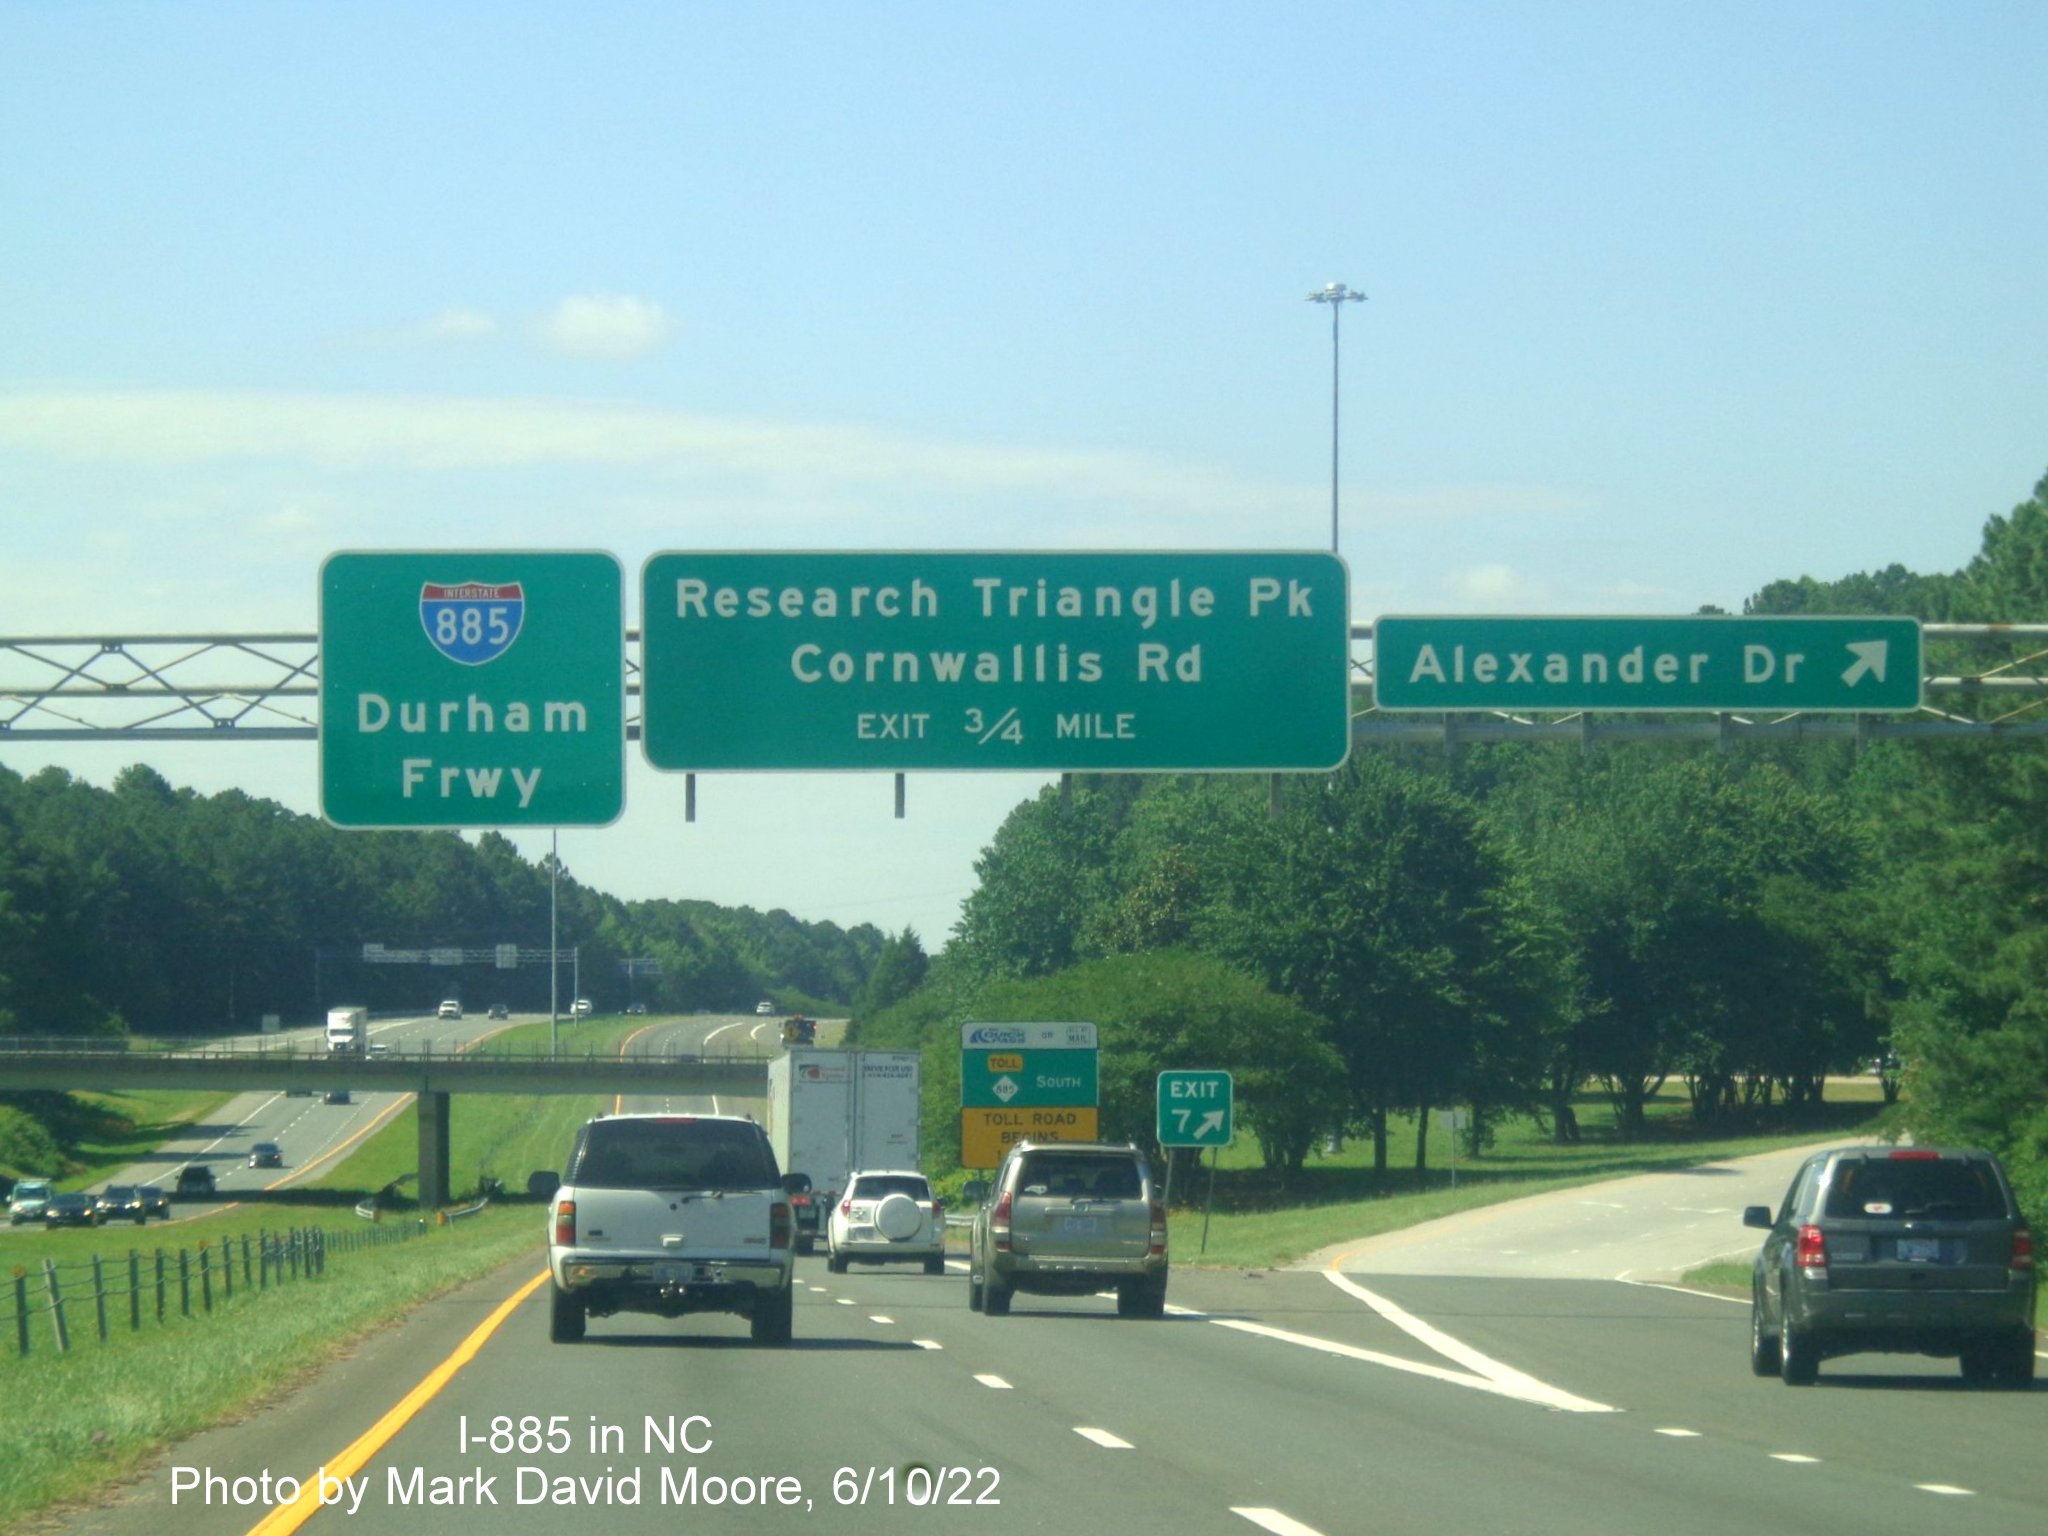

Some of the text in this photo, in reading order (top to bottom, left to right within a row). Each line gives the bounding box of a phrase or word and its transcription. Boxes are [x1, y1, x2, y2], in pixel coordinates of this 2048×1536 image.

[443, 588, 500, 599] INTERSTATE
[676, 577, 1313, 629] Research Triangle Pk
[437, 608, 508, 645] 885
[791, 643, 1202, 682] Cornwallis Rd
[1410, 644, 1804, 683] Alexander Dr
[358, 693, 587, 733] Durham
[857, 708, 1135, 745] EXIT 3/4 MILE
[403, 758, 542, 808] Frwy
[990, 1057, 1021, 1069] TOLL
[1170, 1081, 1219, 1098] EXIT
[984, 1113, 1076, 1126] TOLL ROAD
[1171, 1109, 1191, 1134] 7
